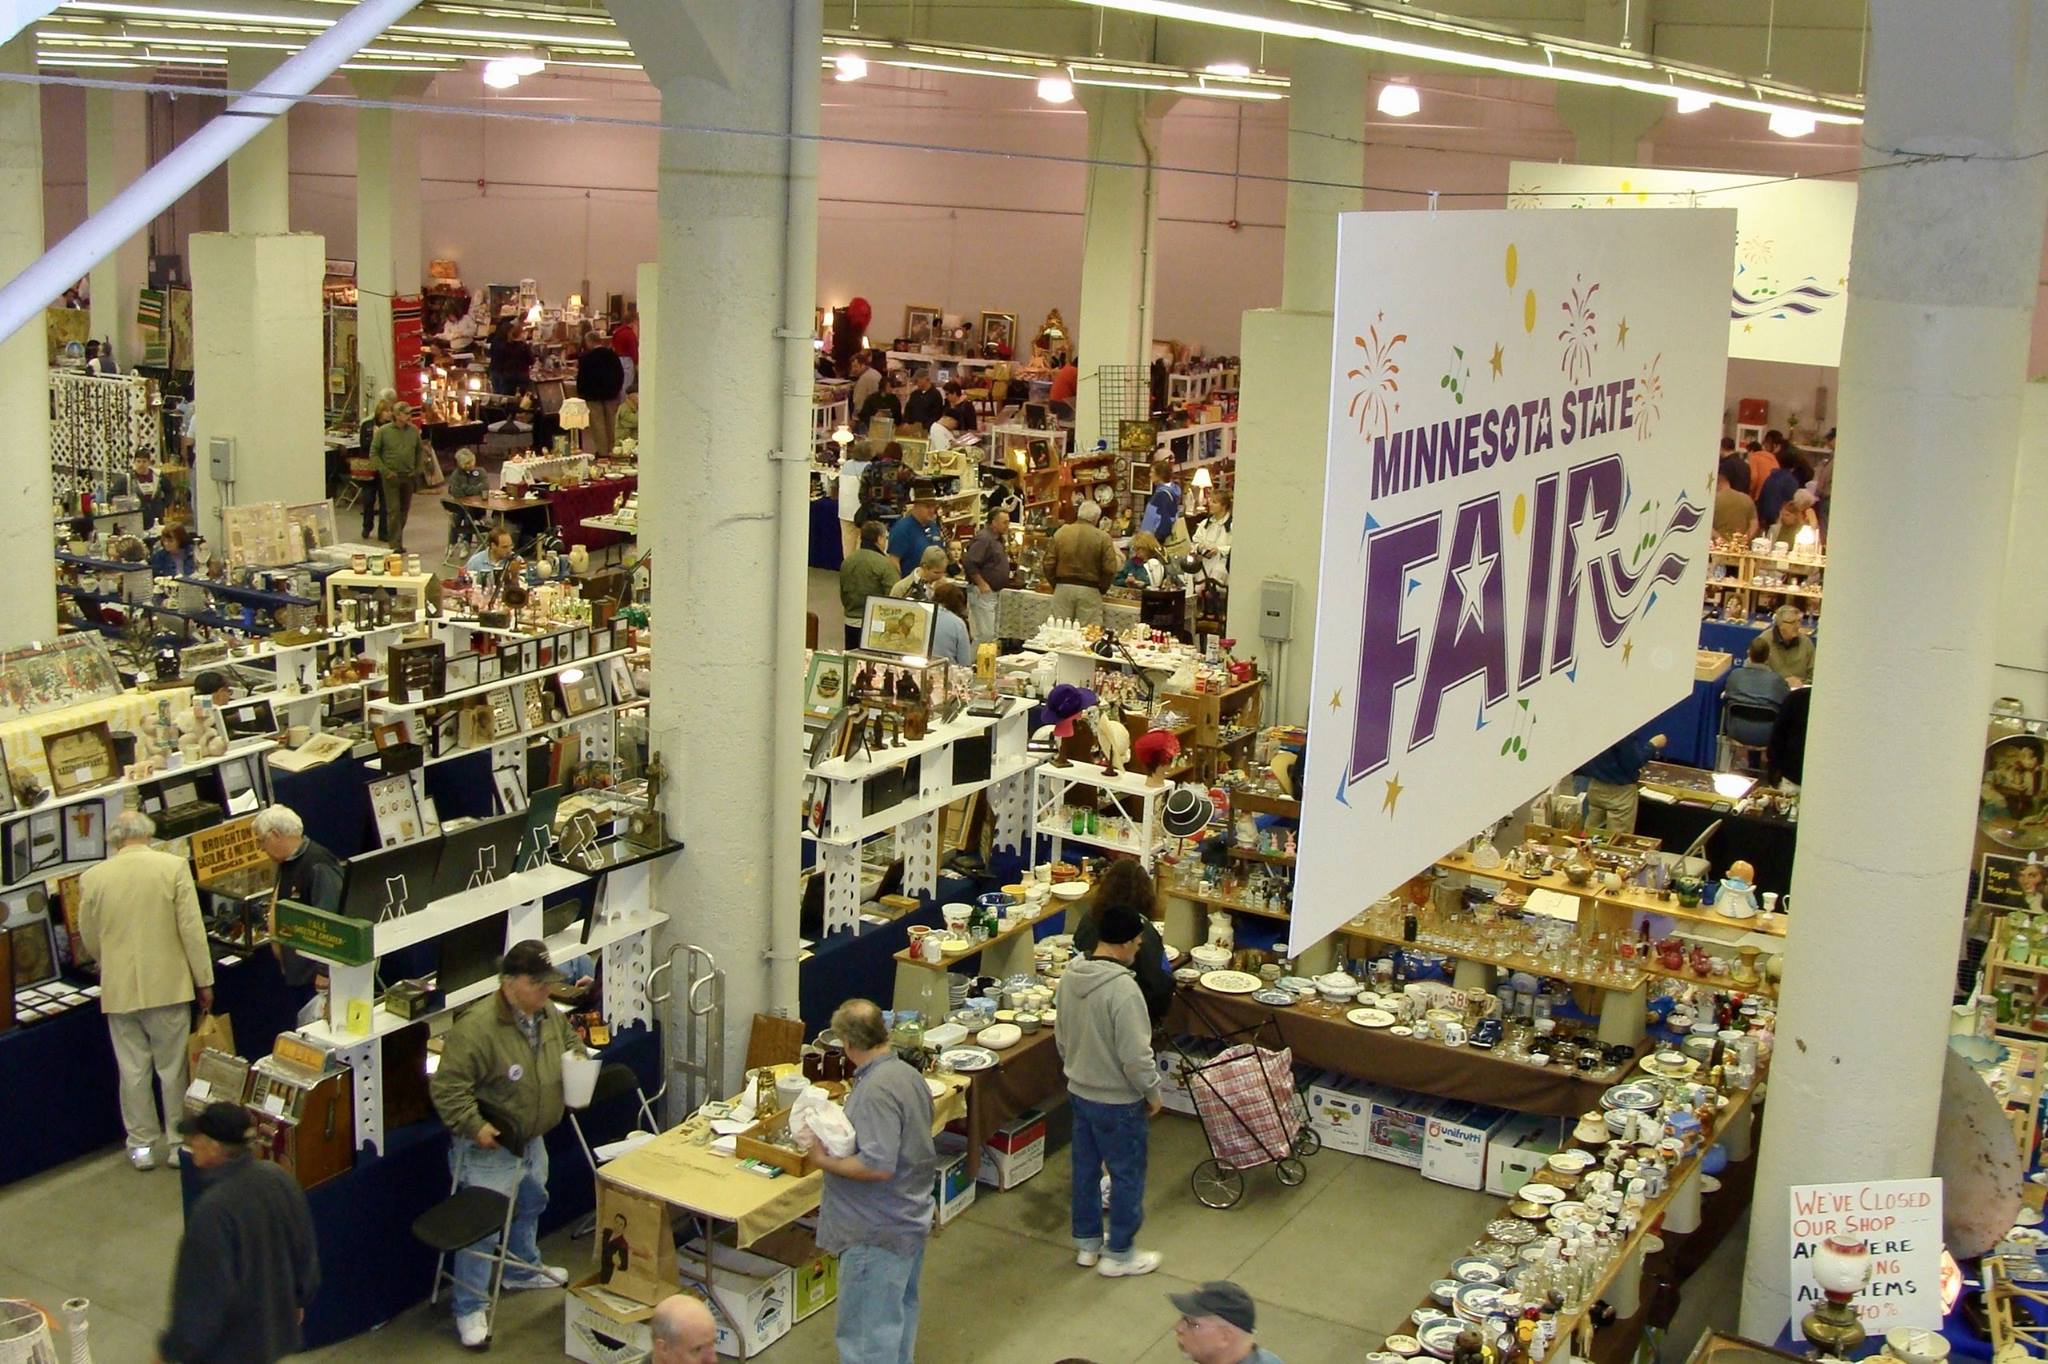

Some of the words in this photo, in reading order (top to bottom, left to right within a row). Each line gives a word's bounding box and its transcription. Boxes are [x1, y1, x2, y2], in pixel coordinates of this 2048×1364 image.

[1370, 397, 1553, 501] MINNESOTA
[1560, 378, 1636, 446] STATE
[1347, 453, 1662, 787] FAIR
[1441, 1125, 1481, 1143] unifrutti
[1860, 1187, 1931, 1211] CLOSED
[1793, 1219, 1837, 1237] OUR
[1845, 1215, 1896, 1233] SHOP
[1863, 1239, 1914, 1257] ERE
